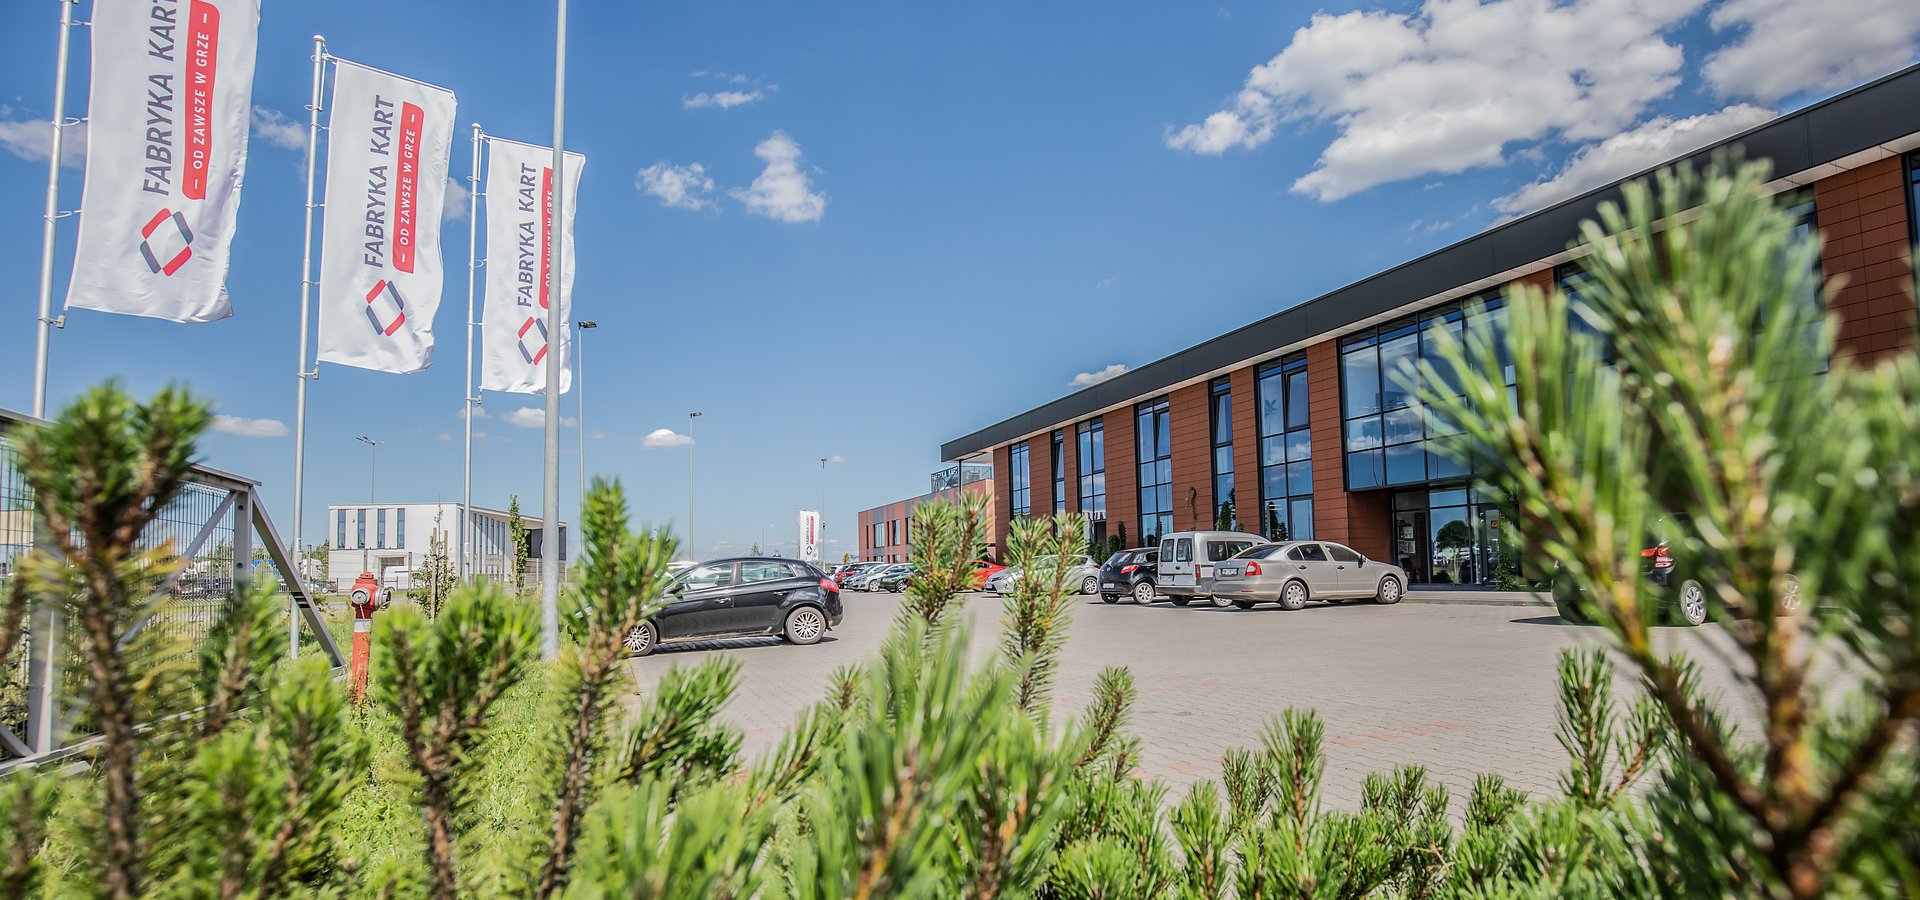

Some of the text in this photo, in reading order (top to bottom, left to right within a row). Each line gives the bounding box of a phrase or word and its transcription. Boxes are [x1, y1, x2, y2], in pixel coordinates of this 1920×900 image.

[143, 0, 178, 196] FABRYKA KAR
[193, 32, 209, 169] OD ZAWSZE W GRZE
[364, 94, 394, 268] FABRYKA KART
[400, 129, 416, 246] OD ZAWSZE W GRZE
[517, 162, 537, 307] FABRYKA KART
